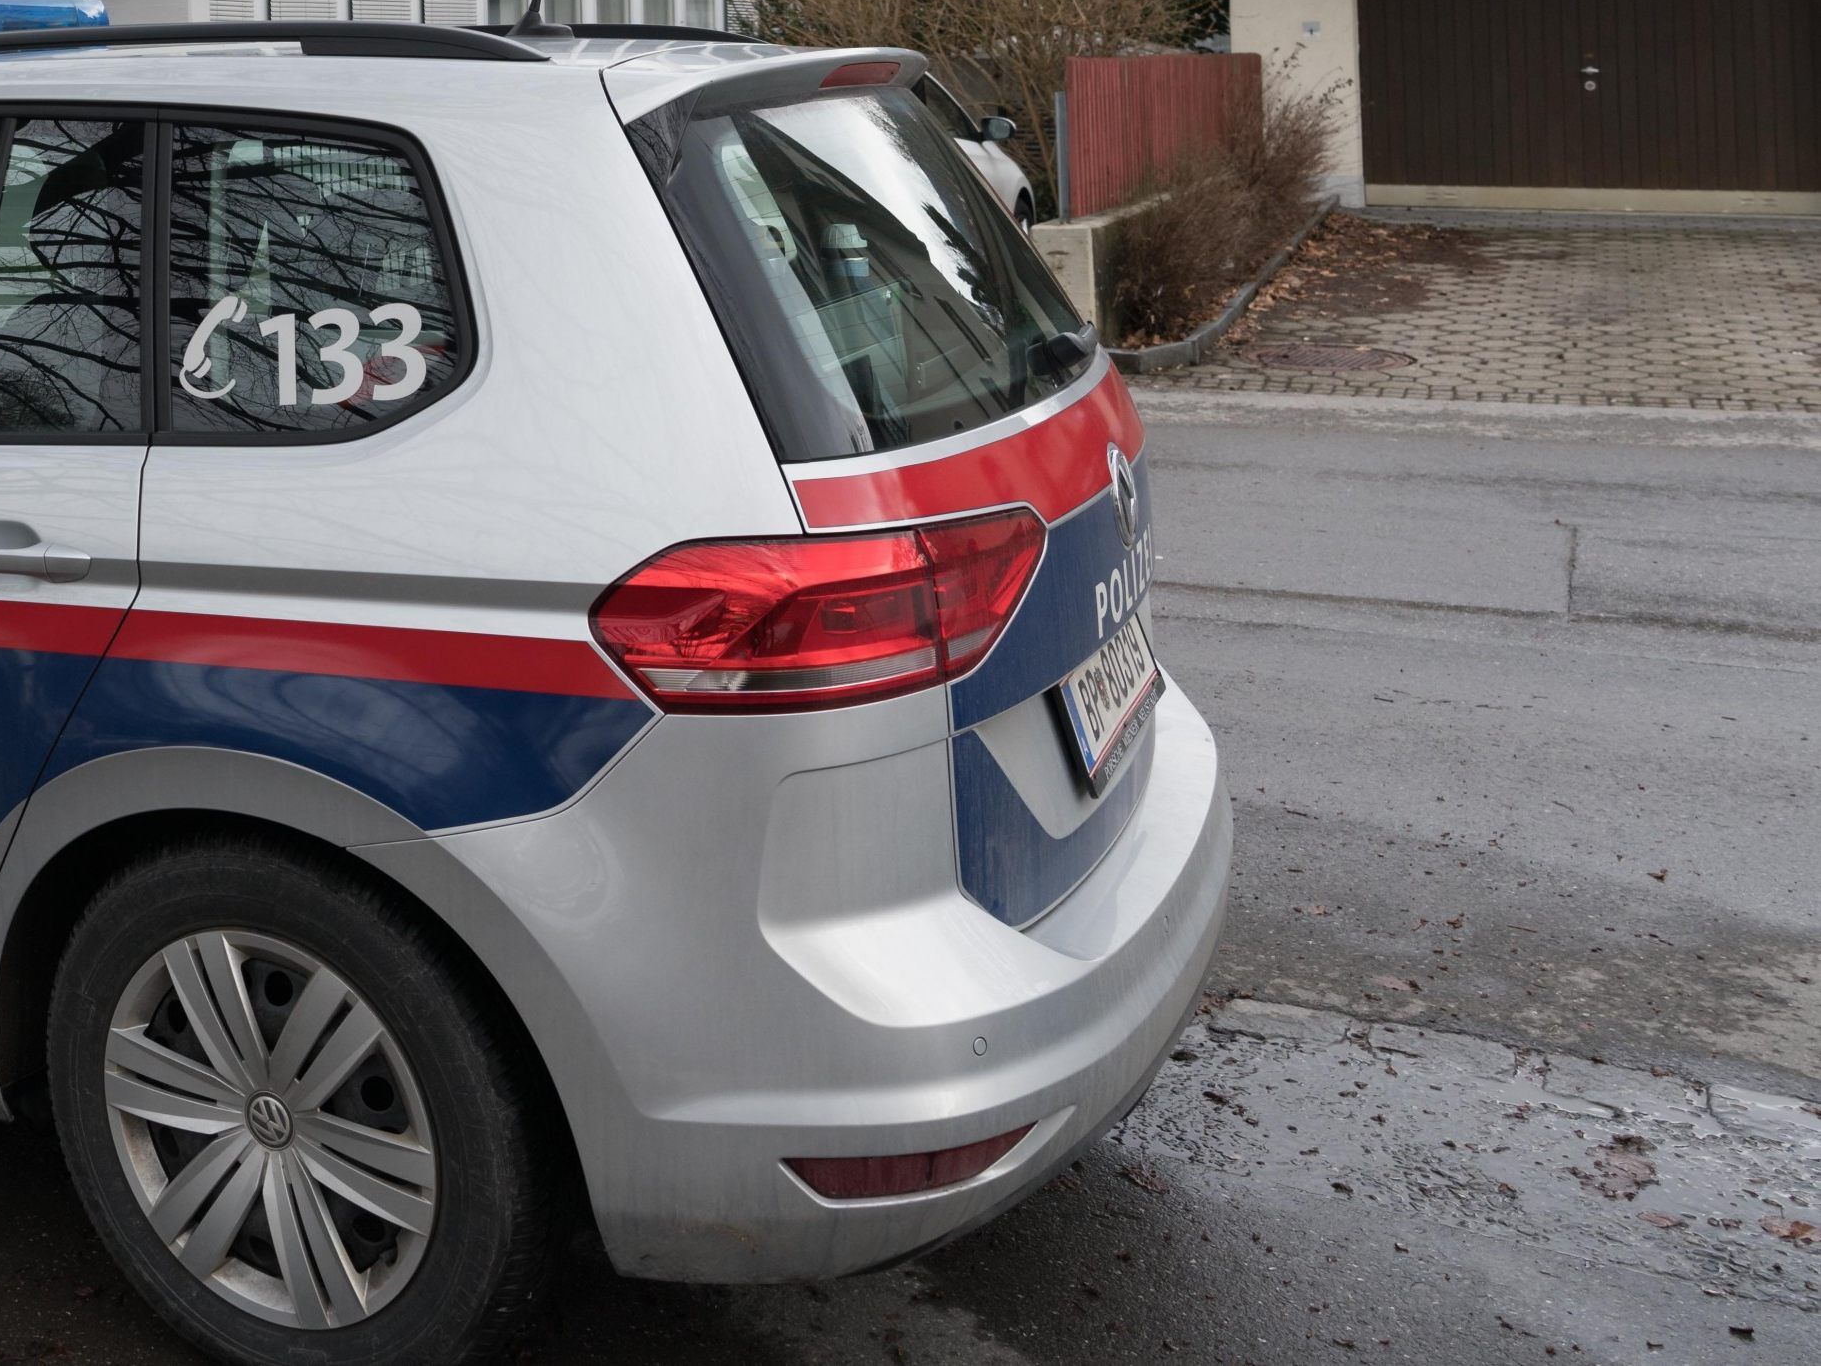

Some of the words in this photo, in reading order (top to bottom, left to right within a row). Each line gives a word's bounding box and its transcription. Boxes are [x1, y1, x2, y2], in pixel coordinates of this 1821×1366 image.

[258, 302, 427, 406] 133
[1095, 523, 1154, 639] POLIZEI
[1078, 669, 1105, 743] BP
[1099, 620, 1146, 709] 80319
[1103, 742, 1127, 780] PORSCHE
[1122, 719, 1139, 747] WIENER
[1137, 689, 1158, 724] NEUSTADT
[249, 1095, 291, 1145] VW
